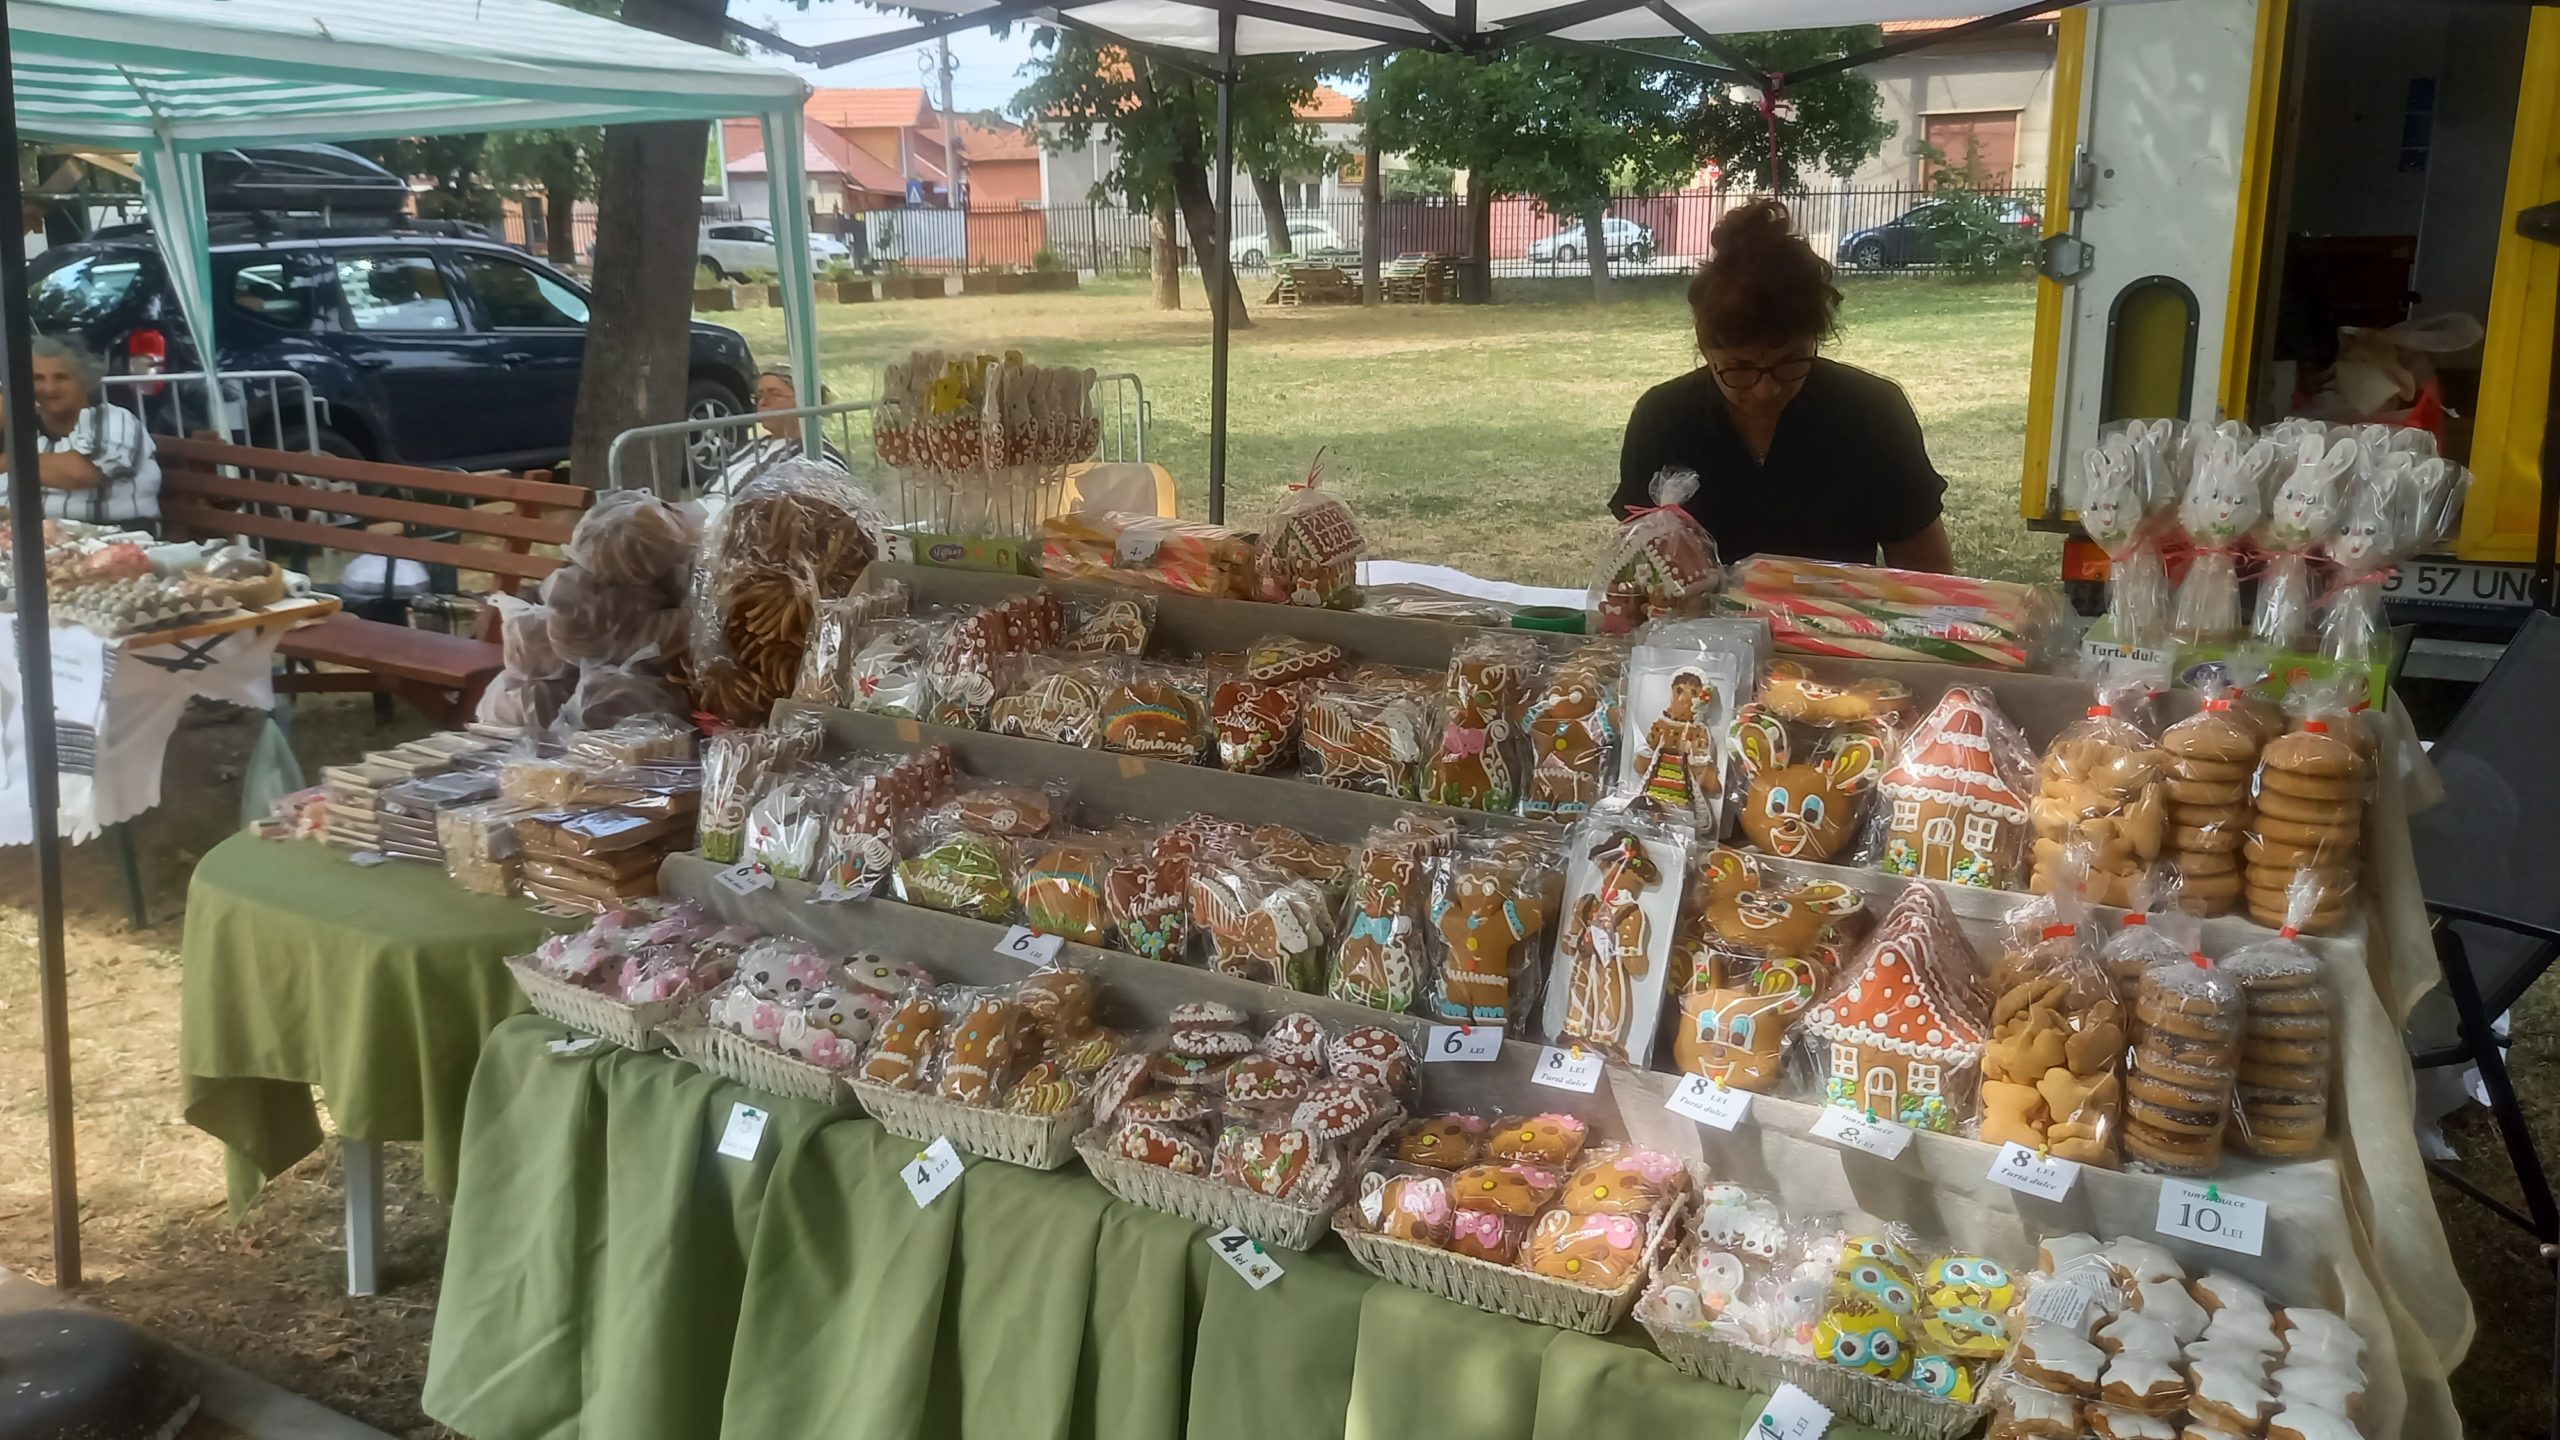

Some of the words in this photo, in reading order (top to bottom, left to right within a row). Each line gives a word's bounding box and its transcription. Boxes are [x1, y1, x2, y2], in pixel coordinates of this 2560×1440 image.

[887, 545, 897, 563] 5
[2418, 566, 2461, 596] 57
[736, 866, 755, 877] 6
[1012, 934, 1038, 951] 6
[1443, 1030, 1464, 1054] 6
[1549, 1052, 1565, 1070] 8
[1569, 1066, 1585, 1074] LEI
[1565, 1078, 1588, 1087] dulce
[1690, 1079, 1709, 1096] 8
[1710, 1095, 1728, 1105] LEI
[1703, 1106, 1728, 1118] dulce
[1838, 1127, 1860, 1142] 8
[917, 1164, 931, 1185] 4
[935, 1159, 950, 1174] LEI
[2012, 1150, 2031, 1168] 8
[2036, 1167, 2056, 1177] LEI
[2029, 1178, 2057, 1190] dulce
[2215, 1197, 2247, 1208] DULCE
[2176, 1203, 2222, 1233] 10
[2222, 1227, 2244, 1239] LEI
[1219, 1235, 1250, 1253] 4
[1232, 1253, 1249, 1265] lei
[1792, 1416, 1809, 1437] LEI
